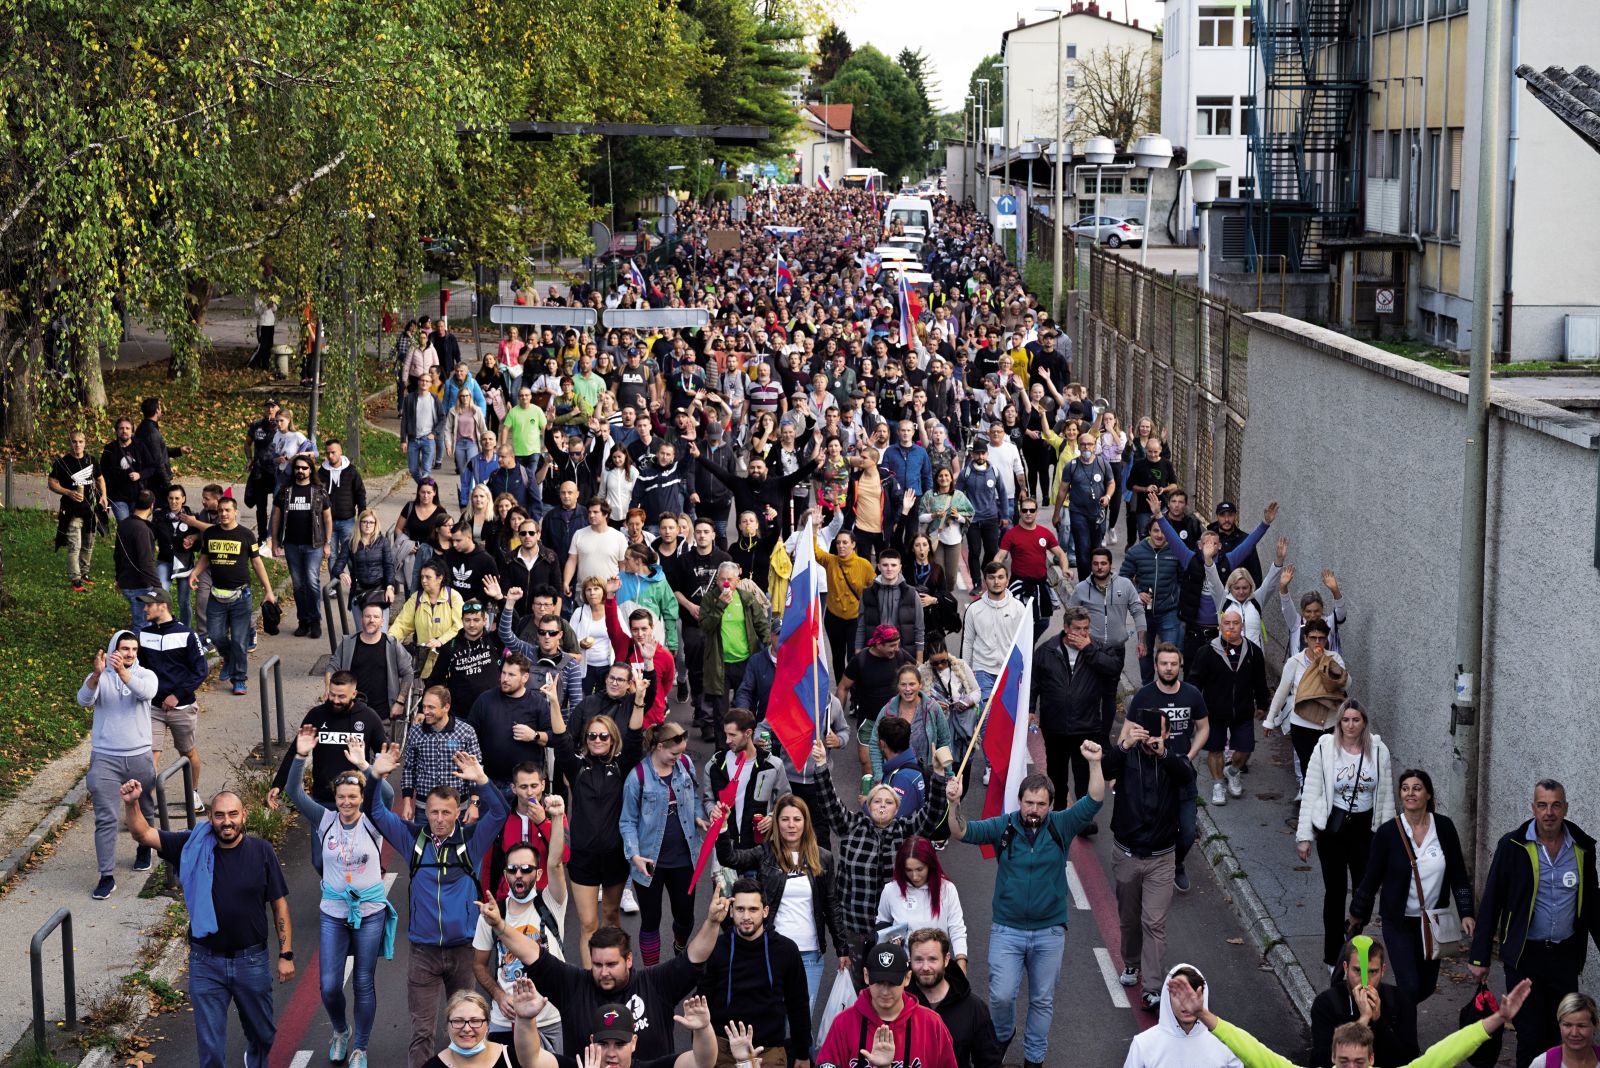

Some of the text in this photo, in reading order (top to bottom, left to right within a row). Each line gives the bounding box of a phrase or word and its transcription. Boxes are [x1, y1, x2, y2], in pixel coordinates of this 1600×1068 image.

[210, 541, 238, 552] NEW YORK
[1170, 720, 1189, 731] NES
